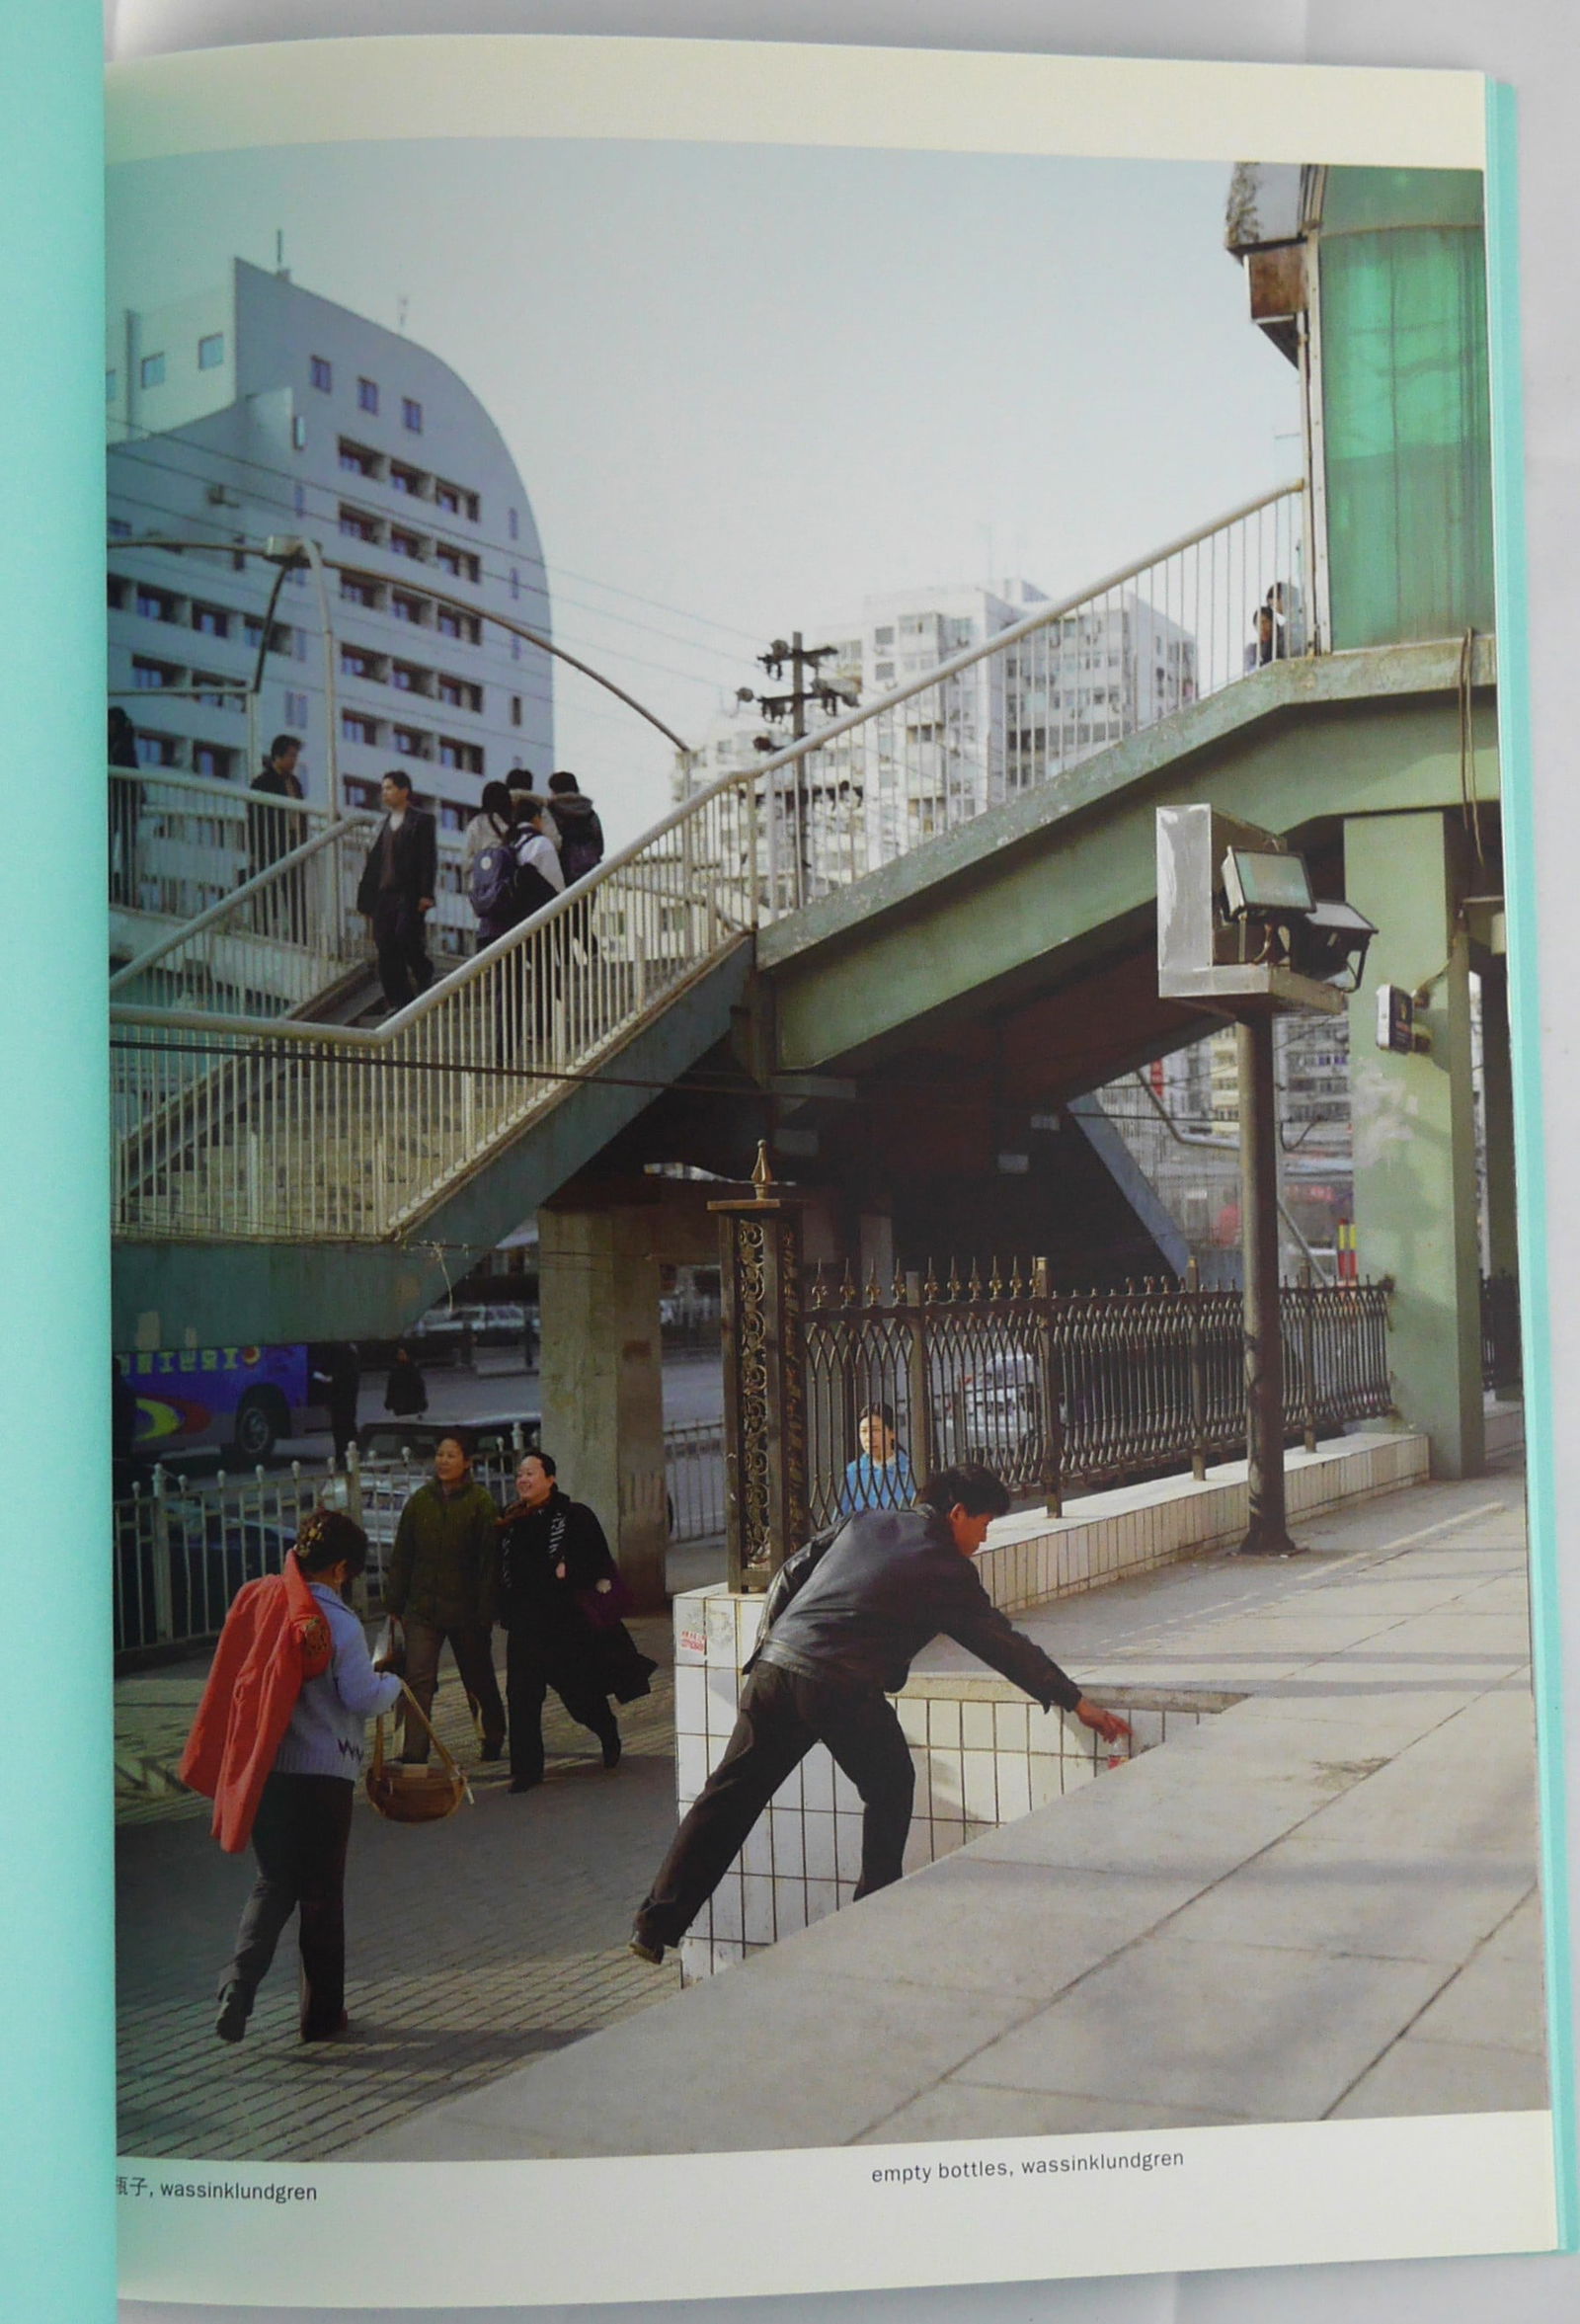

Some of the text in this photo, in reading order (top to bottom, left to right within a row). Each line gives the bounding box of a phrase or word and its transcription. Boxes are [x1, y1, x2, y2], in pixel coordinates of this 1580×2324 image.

[871, 2151, 1184, 2184] empty bottles, wassinklundgren
[160, 2181, 317, 2204] wassinklundgren
